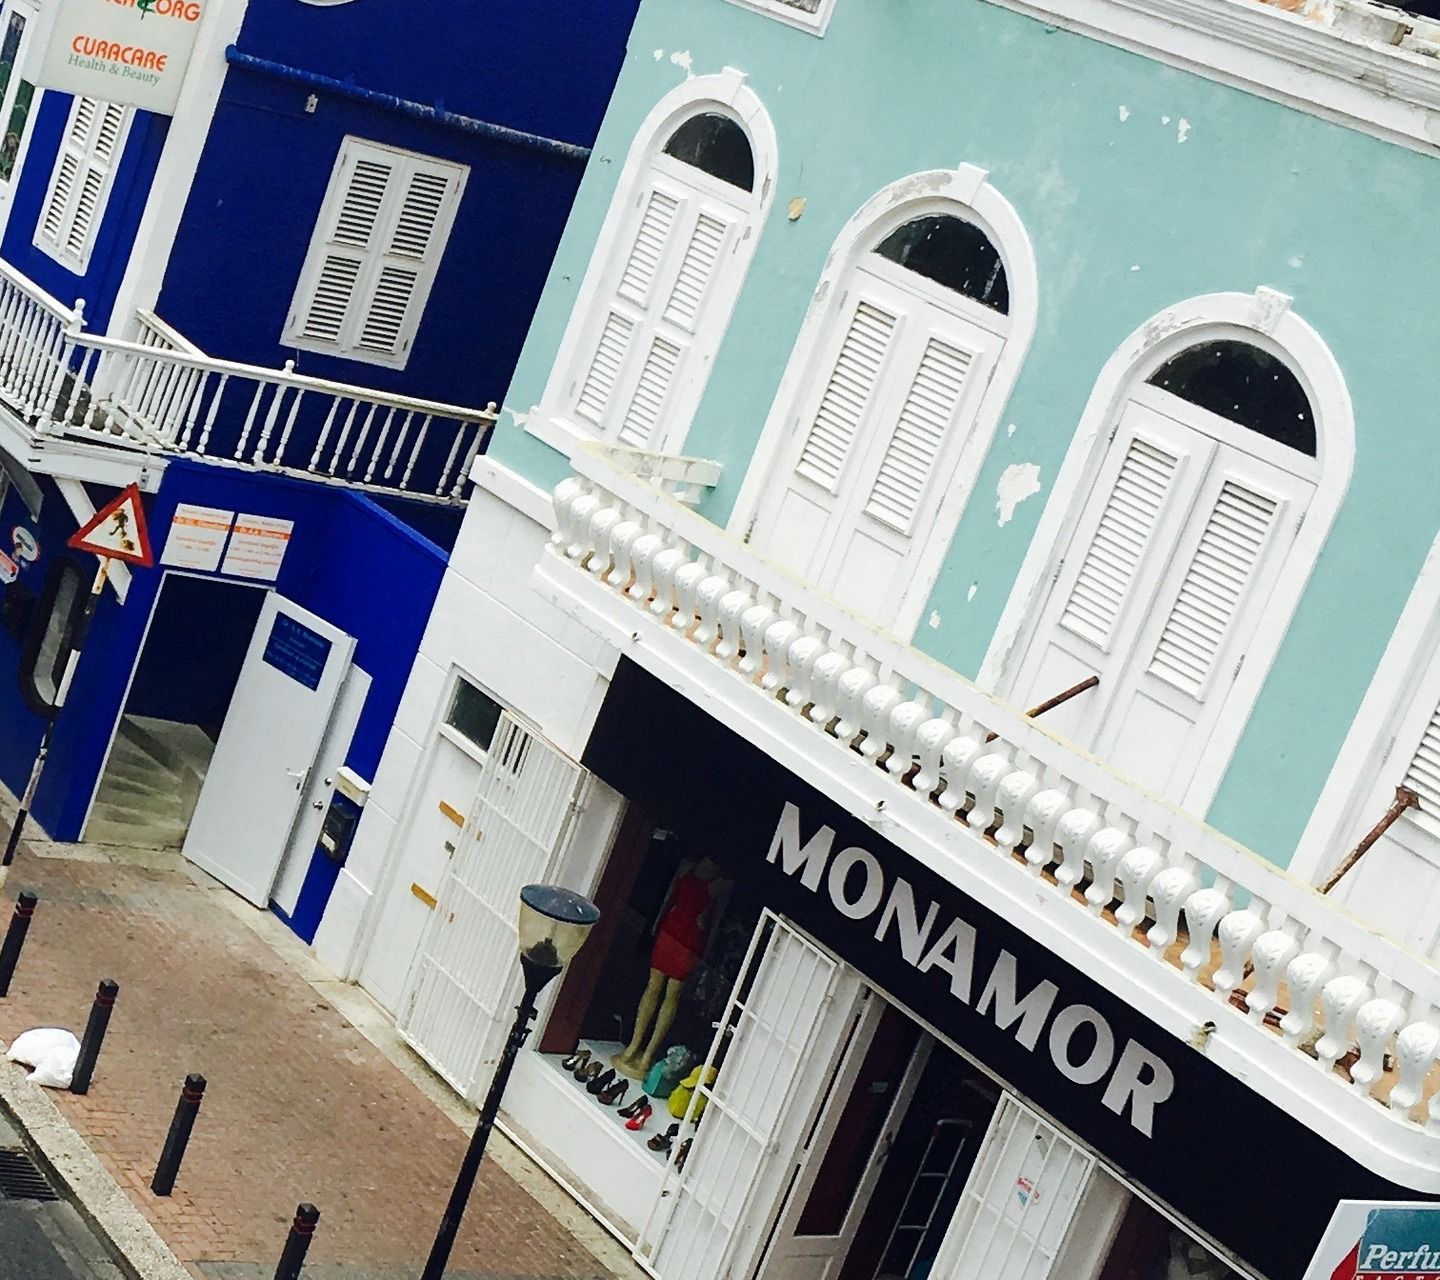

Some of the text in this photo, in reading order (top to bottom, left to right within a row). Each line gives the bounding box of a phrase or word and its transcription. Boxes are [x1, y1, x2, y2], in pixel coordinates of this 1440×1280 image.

[68, 54, 160, 87] Health & Beauty
[72, 35, 168, 72] CURACARE
[765, 800, 1175, 1139] MONAMOR
